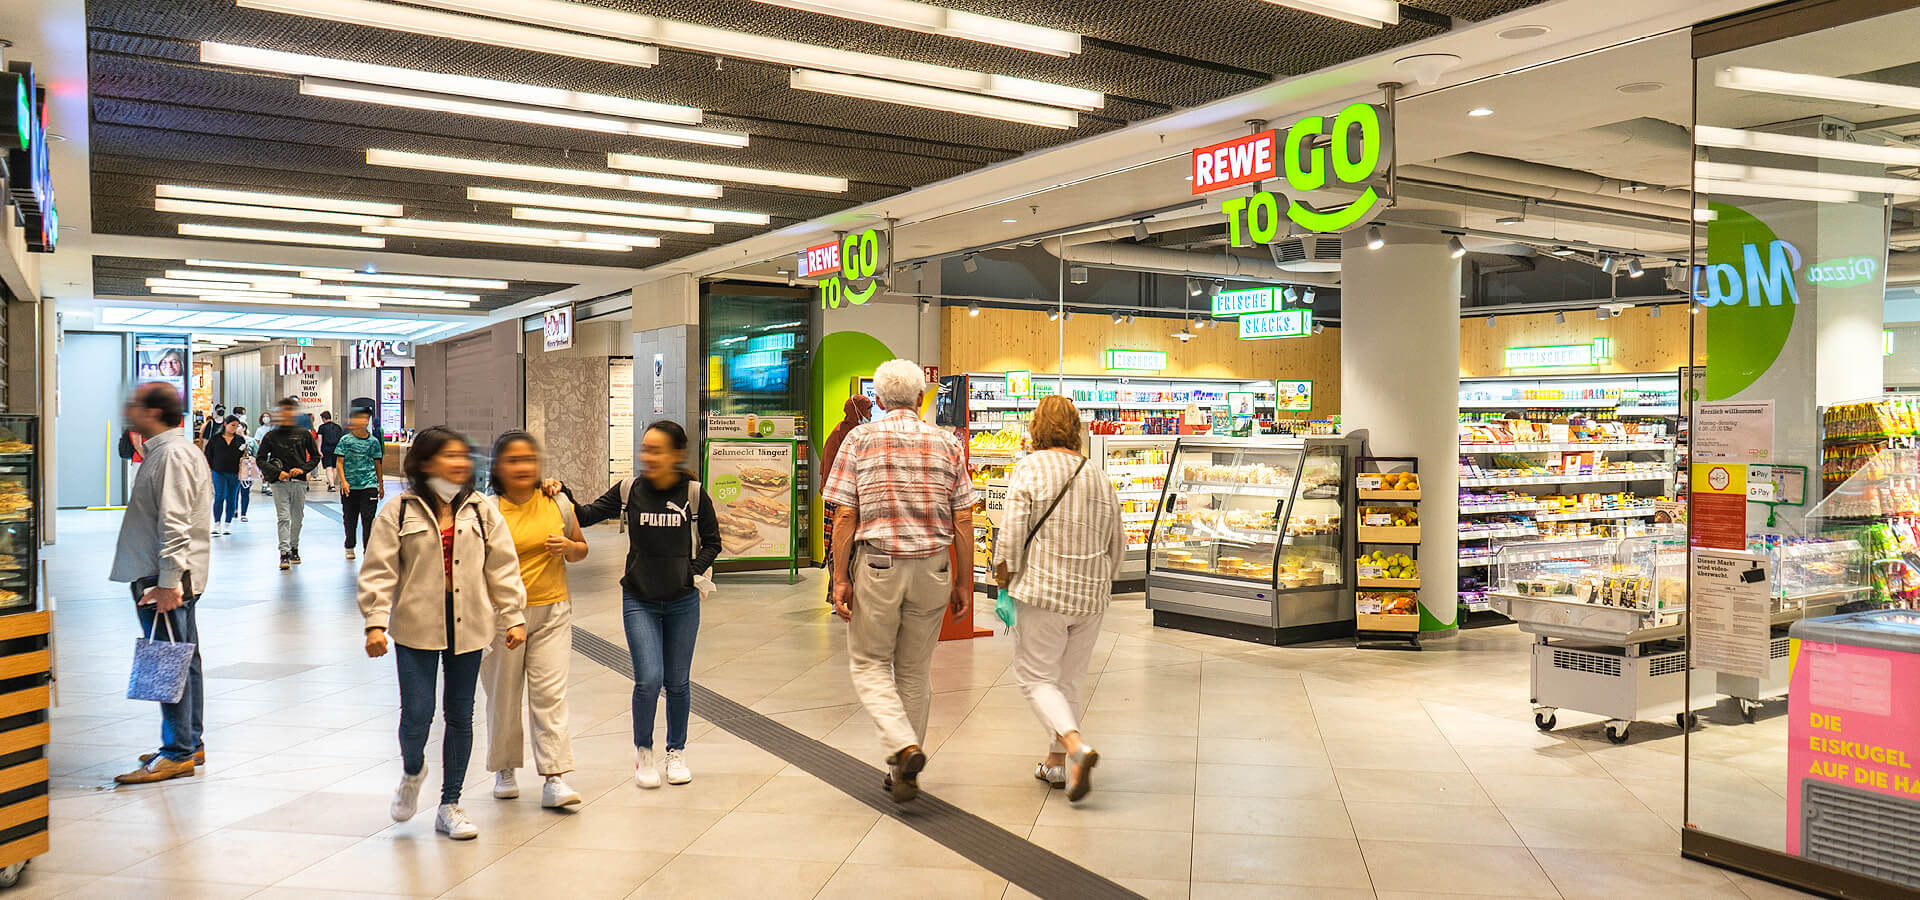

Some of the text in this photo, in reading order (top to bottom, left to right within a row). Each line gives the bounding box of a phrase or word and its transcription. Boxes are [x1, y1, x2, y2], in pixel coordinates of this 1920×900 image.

[1196, 103, 1381, 191] REWE GO
[1222, 191, 1279, 247] TO
[808, 229, 878, 280] REWE GO
[819, 276, 841, 310] TO
[1217, 292, 1267, 312] FRISCHE
[1245, 315, 1296, 334] SNACKS.
[287, 352, 305, 376] KFC
[1724, 407, 1763, 415] willkommen!
[712, 448, 788, 458] Schmeckt länger!
[1756, 471, 1768, 479] Pay
[988, 489, 1007, 500] Frisc
[1758, 488, 1769, 497] Pay
[639, 512, 682, 527] PUMA
[1697, 557, 1736, 567] Dieser Markt
[1697, 570, 1729, 579] überwacht.
[1809, 711, 1842, 733] DIE
[1809, 735, 1912, 769] EISKUGEL
[1809, 759, 1849, 780] AUF
[1854, 767, 1889, 789] DIE
